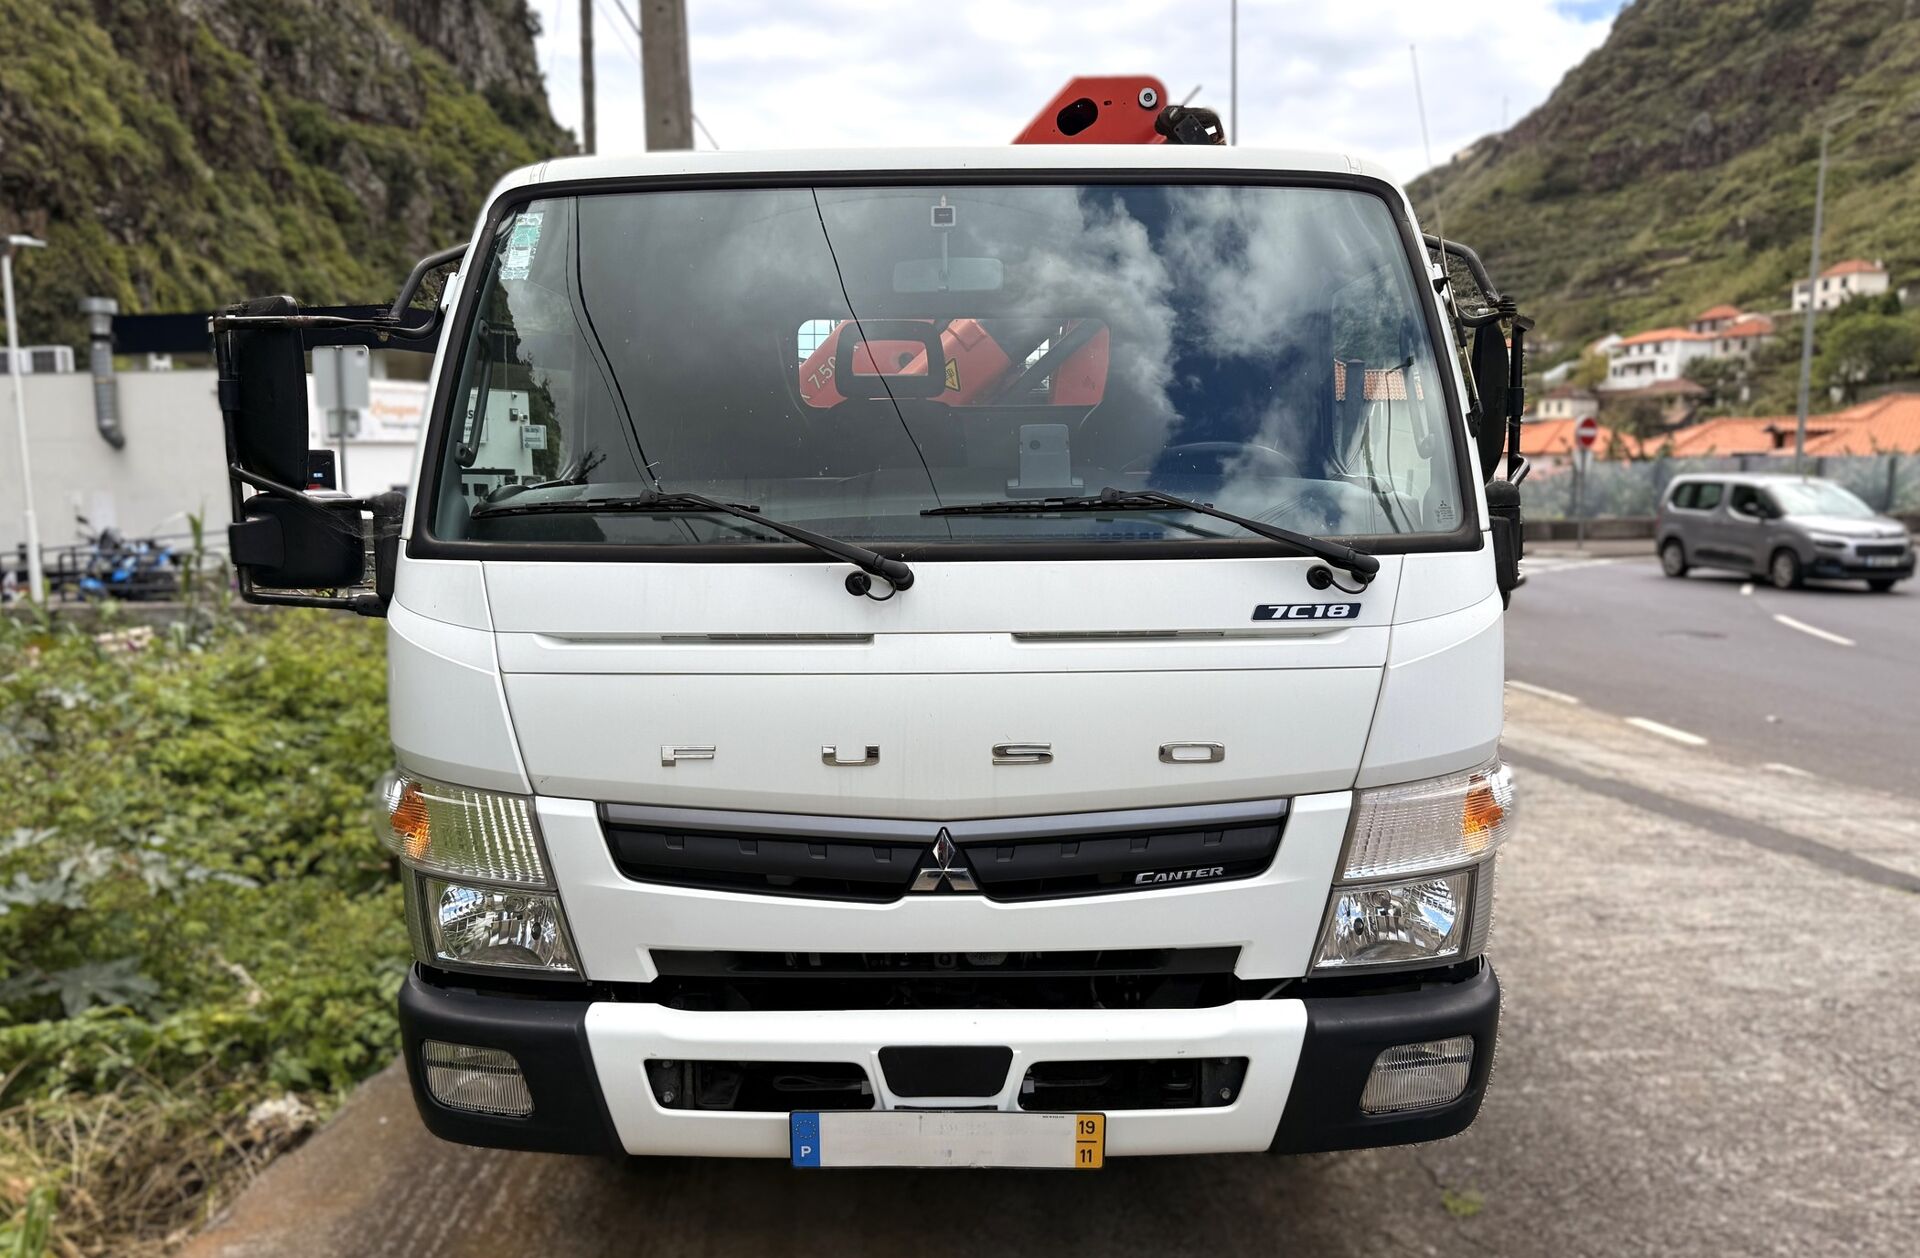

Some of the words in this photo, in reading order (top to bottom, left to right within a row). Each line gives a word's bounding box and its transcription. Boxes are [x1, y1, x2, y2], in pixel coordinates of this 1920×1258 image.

[1268, 604, 1351, 619] 7C18
[661, 740, 1225, 767] FUSO
[1135, 866, 1224, 885] CANTER
[1079, 1120, 1096, 1135] 19
[801, 1145, 812, 1157] P
[1080, 1148, 1093, 1163] 11
